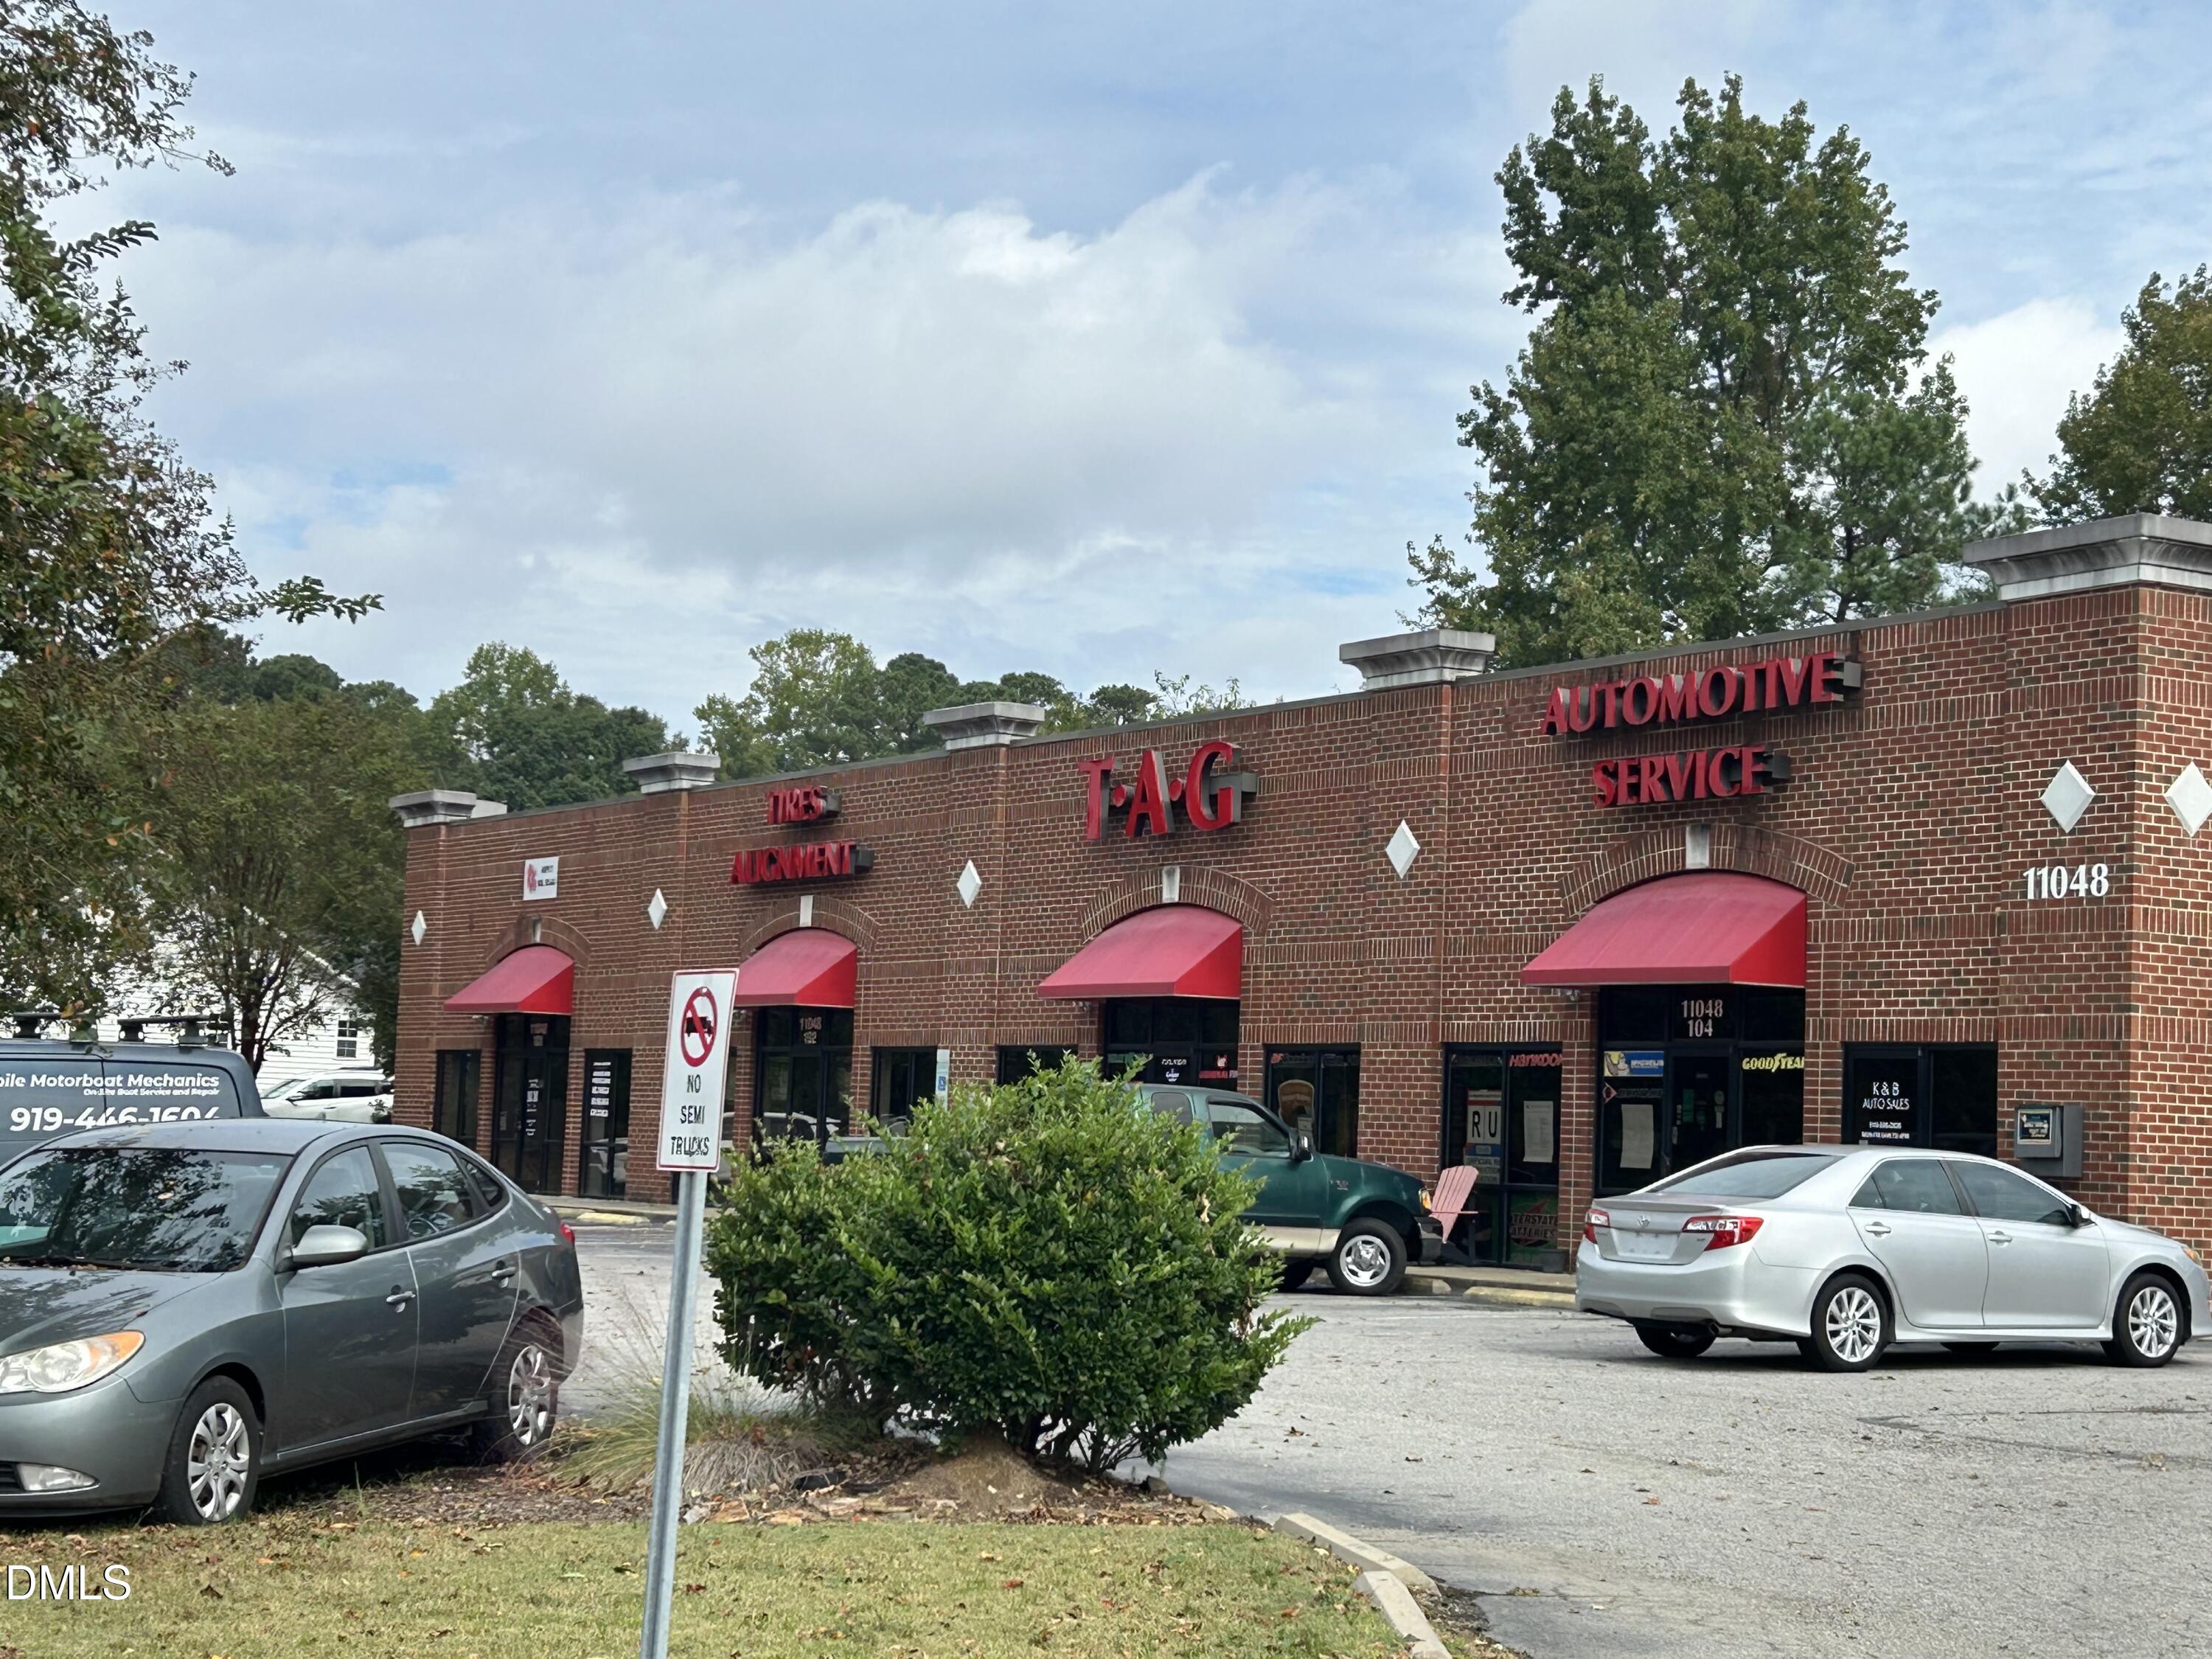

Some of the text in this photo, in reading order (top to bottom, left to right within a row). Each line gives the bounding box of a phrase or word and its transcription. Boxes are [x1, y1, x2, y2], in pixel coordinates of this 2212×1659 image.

[1542, 652, 1843, 736] AUTOMOTIVE
[1593, 744, 1772, 807] SERVICE
[767, 786, 827, 824] TIRES
[730, 838, 858, 884] ALIGNMENT
[2023, 863, 2109, 900] 11048
[1681, 999, 1724, 1018] 11048
[1687, 1018, 1714, 1037] 104
[30, 1074, 123, 1088] Motorboat
[128, 1073, 220, 1088] Mechanics
[686, 1074, 701, 1093] NO
[1873, 1082, 1879, 1096] K
[191, 1088, 220, 1096] Repair
[1863, 1098, 1885, 1110] AUTO
[680, 1105, 706, 1124] SEMI
[671, 1136, 710, 1157] TRUCKS
